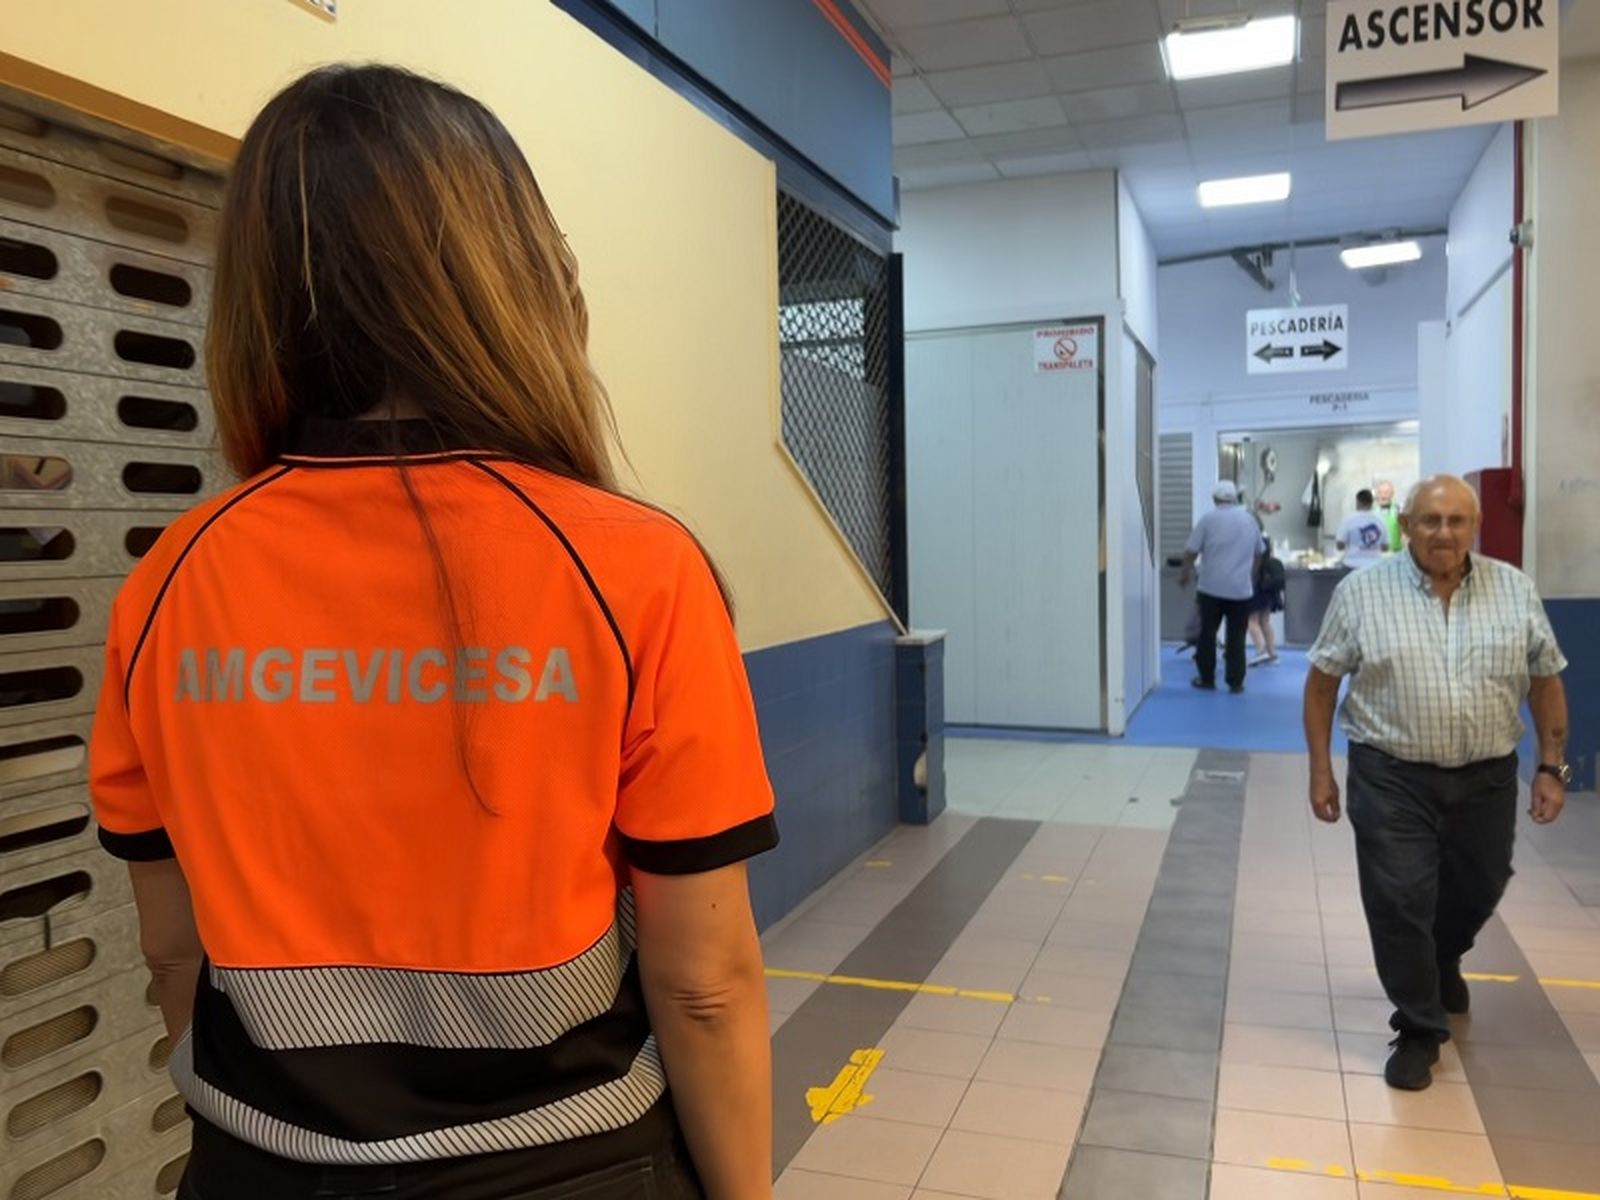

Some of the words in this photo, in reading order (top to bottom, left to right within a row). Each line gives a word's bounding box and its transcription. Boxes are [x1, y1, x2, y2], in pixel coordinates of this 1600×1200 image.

[1338, 0, 1545, 52] ASCENSOR
[1250, 313, 1345, 336] PESCADERÍA
[176, 647, 580, 703] AMGEVICESA
